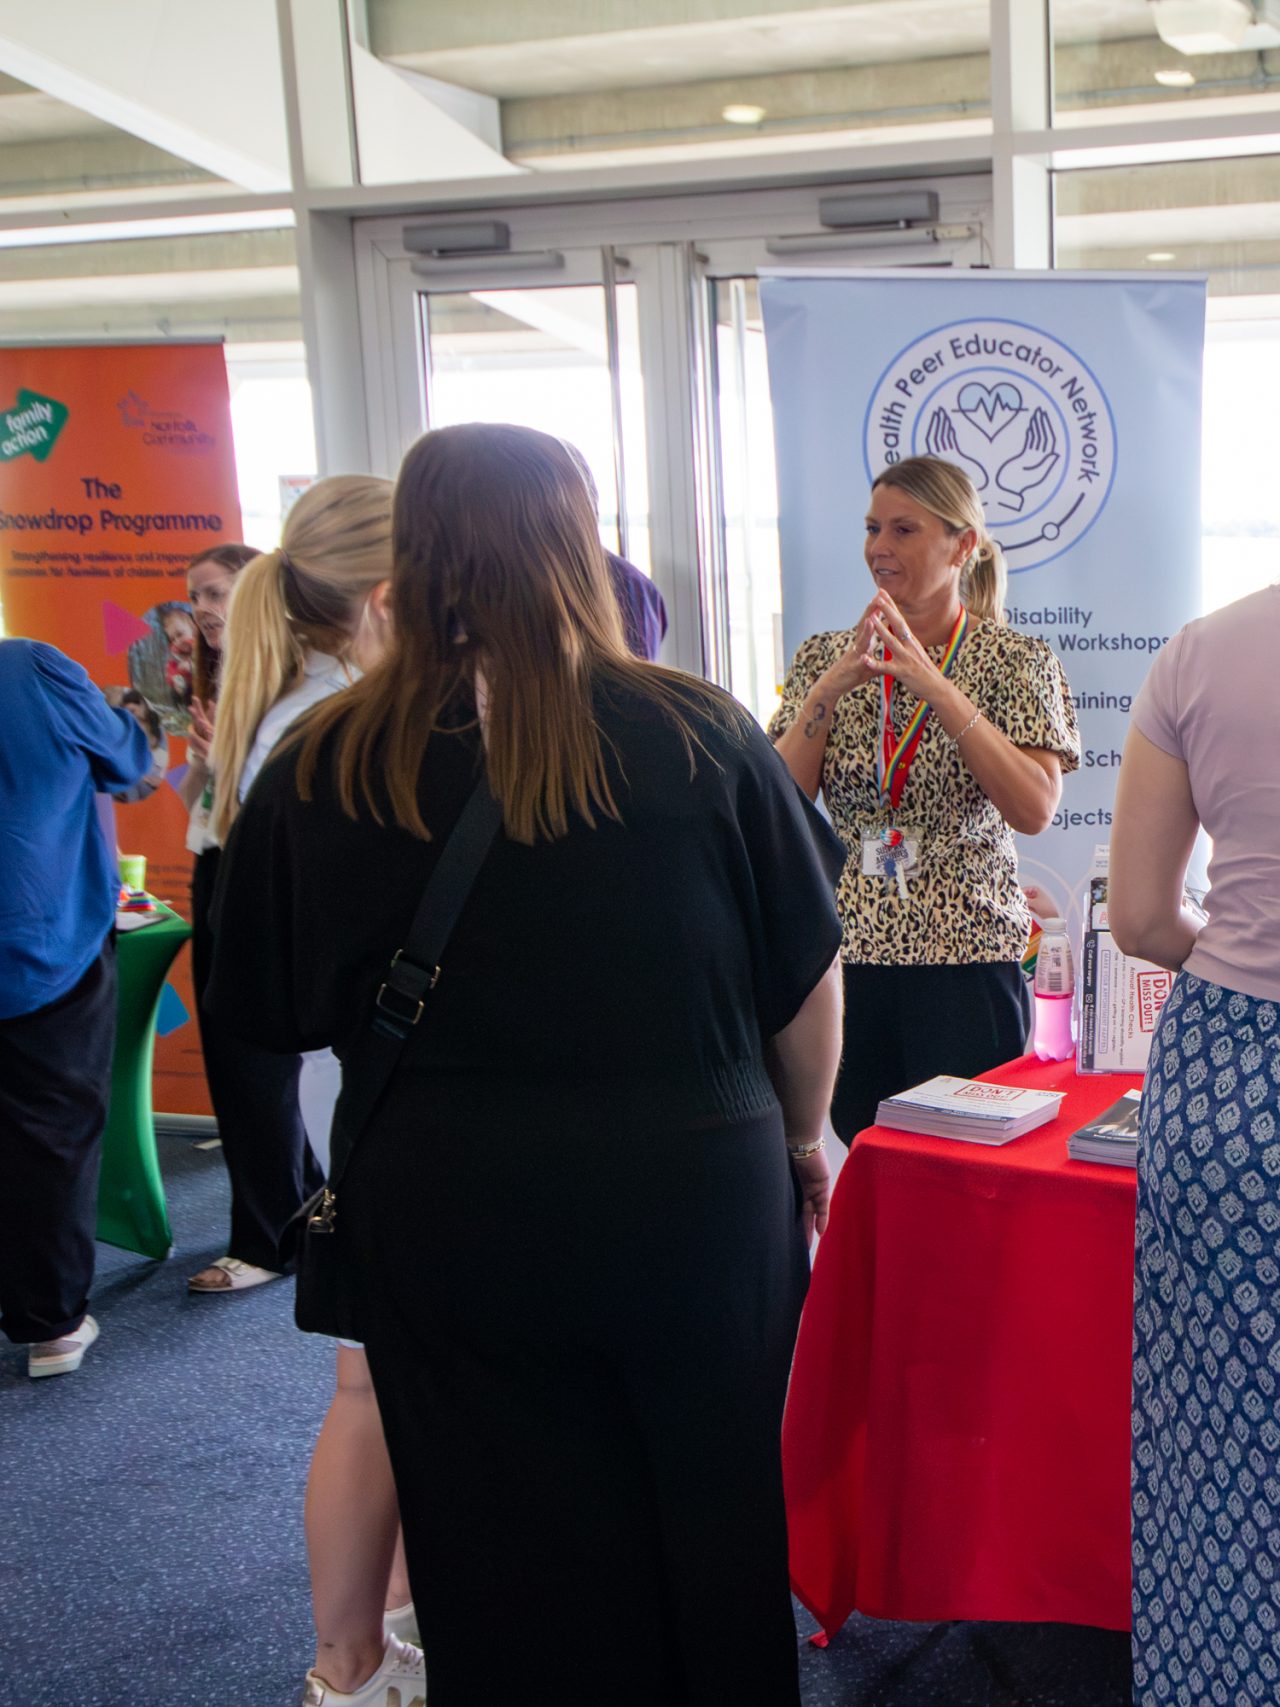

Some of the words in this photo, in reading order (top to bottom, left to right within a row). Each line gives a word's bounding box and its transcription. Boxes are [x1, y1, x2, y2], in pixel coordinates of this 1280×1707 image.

[6, 401, 53, 434] family
[880, 401, 906, 465] ealth
[895, 350, 945, 398] Peer
[949, 333, 1063, 378] Educator
[1060, 376, 1100, 484] Network
[1, 425, 49, 456] action
[81, 477, 122, 499] The
[99, 510, 223, 536] Programme
[1058, 634, 1169, 653] Workshops
[1085, 750, 1122, 767] Sch
[1051, 809, 1112, 830] ojects
[1142, 980, 1152, 1000] MISS
[1143, 1004, 1154, 1025] OUT!
[1127, 1014, 1135, 1039] Checks
